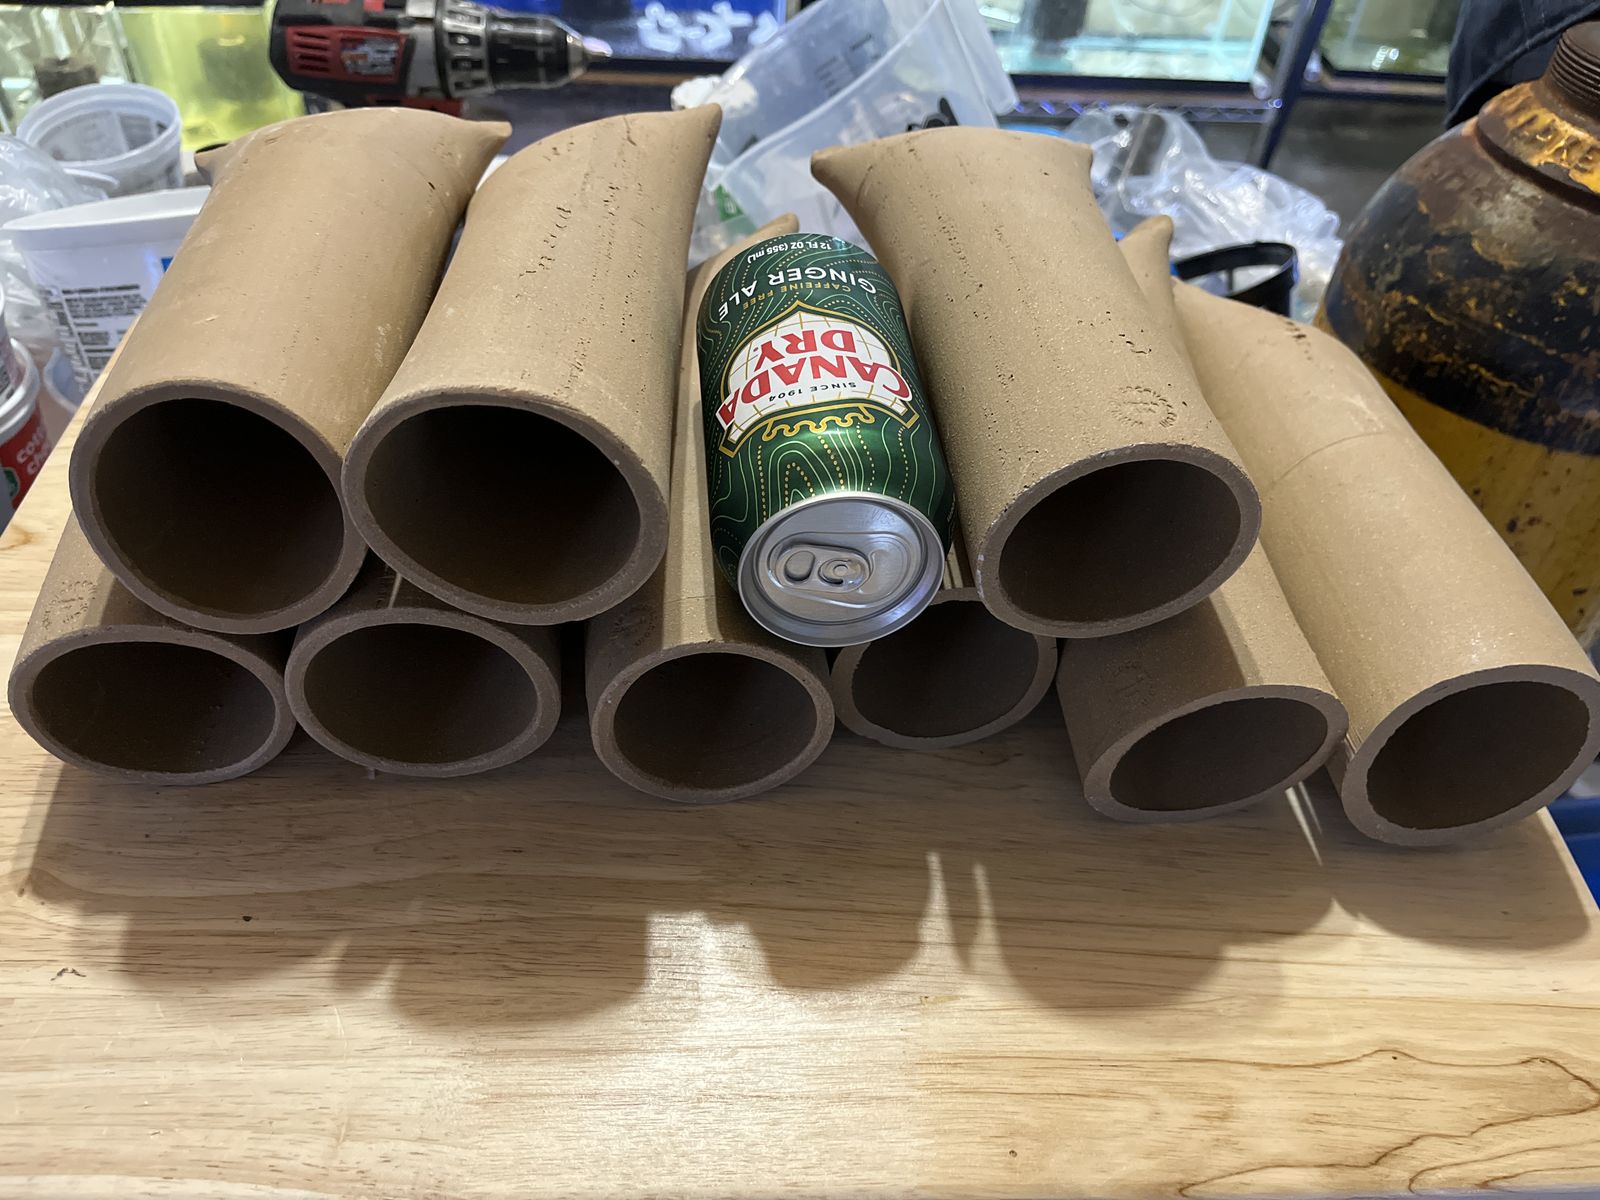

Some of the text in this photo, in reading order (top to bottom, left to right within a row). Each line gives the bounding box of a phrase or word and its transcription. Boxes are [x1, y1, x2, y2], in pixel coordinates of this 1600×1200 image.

[766, 242, 789, 256] (355
[789, 241, 804, 250] OZ
[804, 240, 818, 250] FL
[819, 241, 832, 251] 12
[717, 266, 877, 321] GINGER ALE
[742, 281, 851, 310] CAFFEINE FREE
[718, 355, 910, 427] CANADA
[767, 382, 856, 402] SINCE 1904
